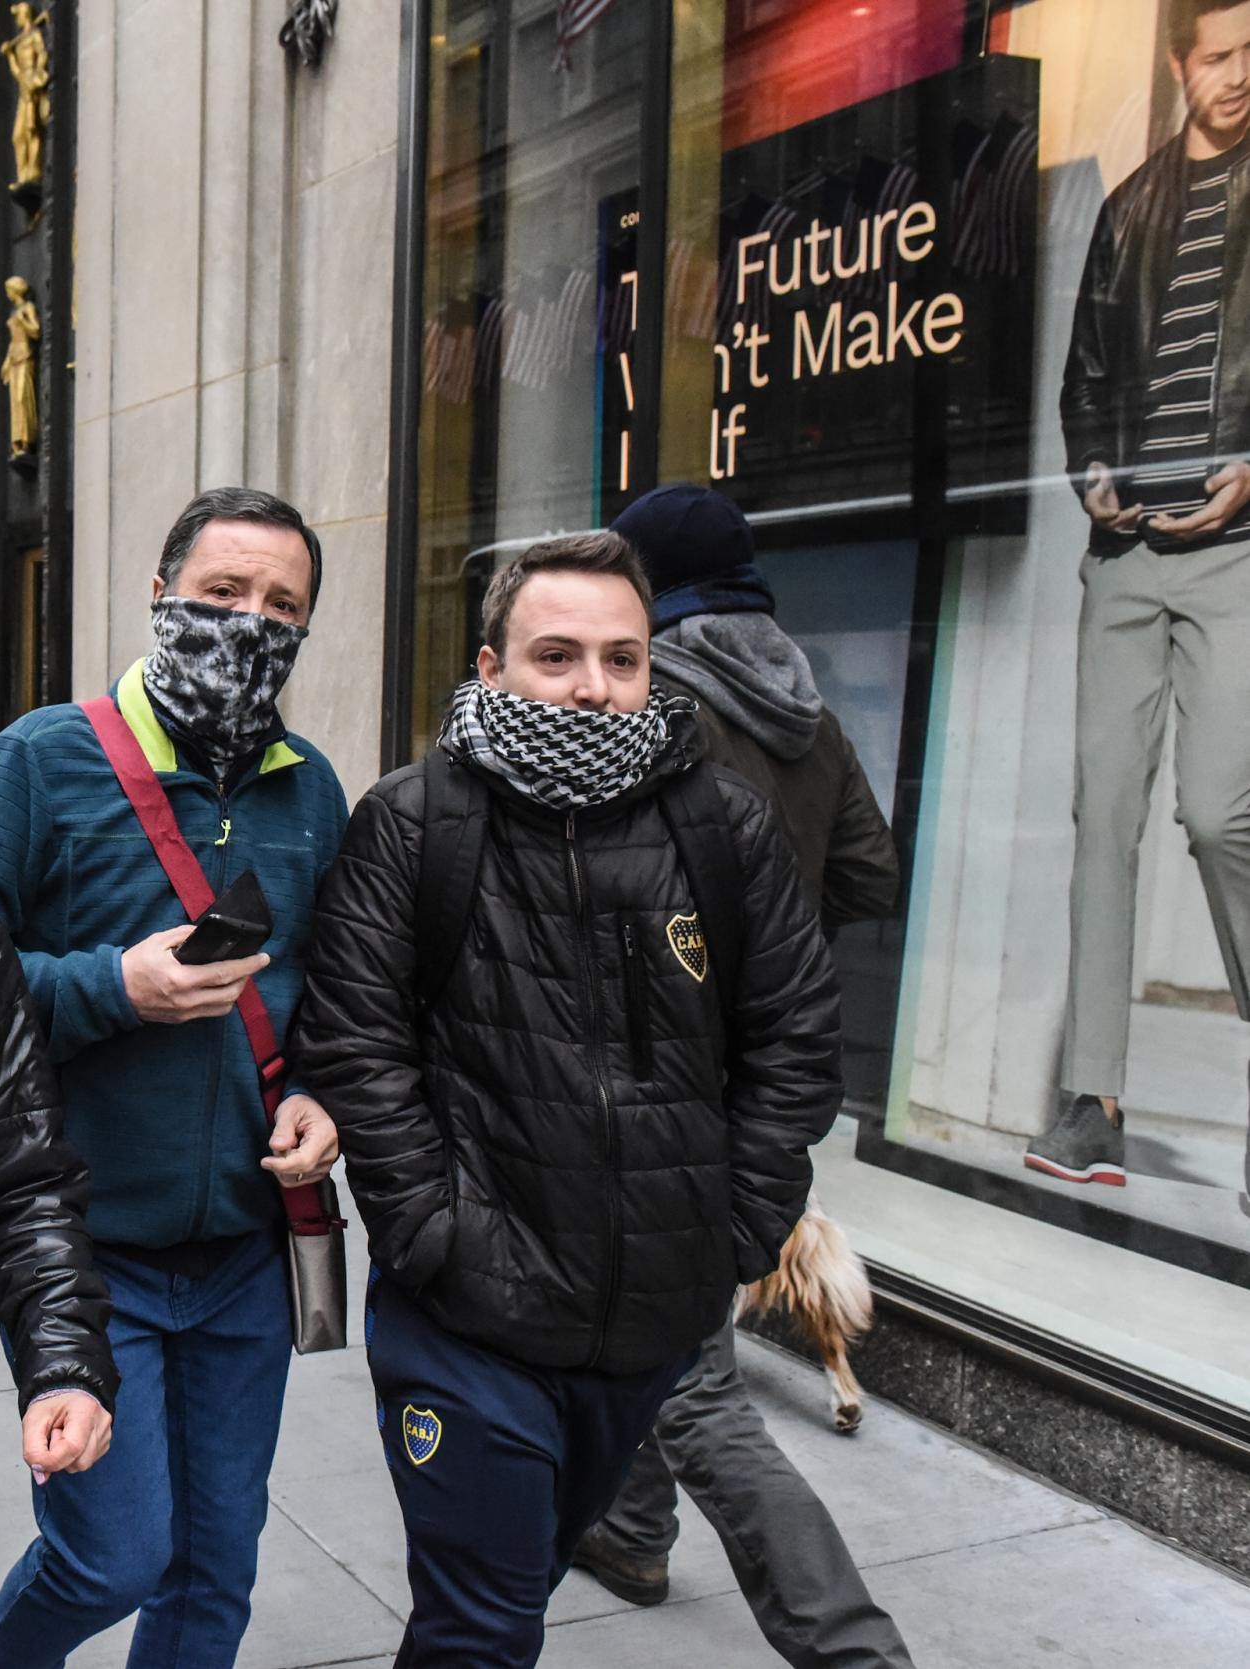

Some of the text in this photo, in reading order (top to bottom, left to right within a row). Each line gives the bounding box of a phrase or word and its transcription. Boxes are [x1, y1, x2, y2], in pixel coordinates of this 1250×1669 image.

[737, 201, 936, 304] Future
[793, 281, 964, 380] Make
[406, 1423, 435, 1442] CABJ
